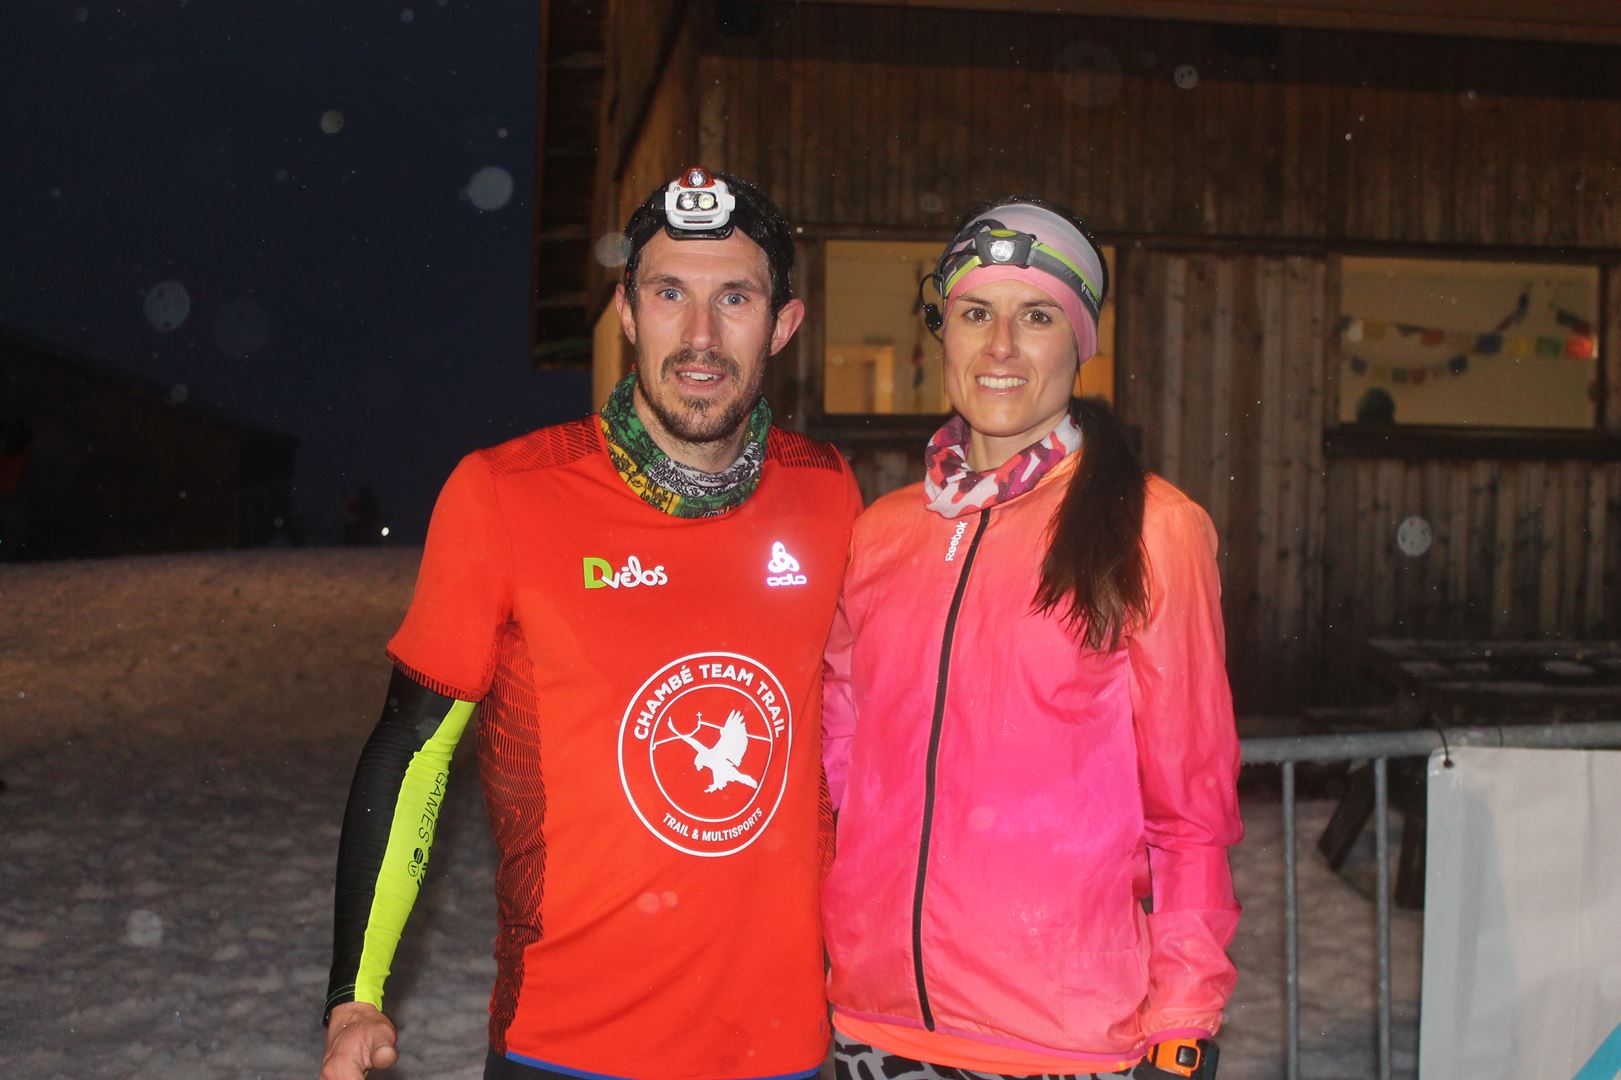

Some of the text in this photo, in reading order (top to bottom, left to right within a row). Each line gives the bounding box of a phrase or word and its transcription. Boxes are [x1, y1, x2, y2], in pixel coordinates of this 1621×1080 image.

[945, 521, 968, 561] Reebok
[634, 664, 785, 740] CHAMBÉ TEAM TRAIL
[418, 772, 447, 843] GAMES
[663, 808, 763, 842] TRAIL & MULTISPORTS
